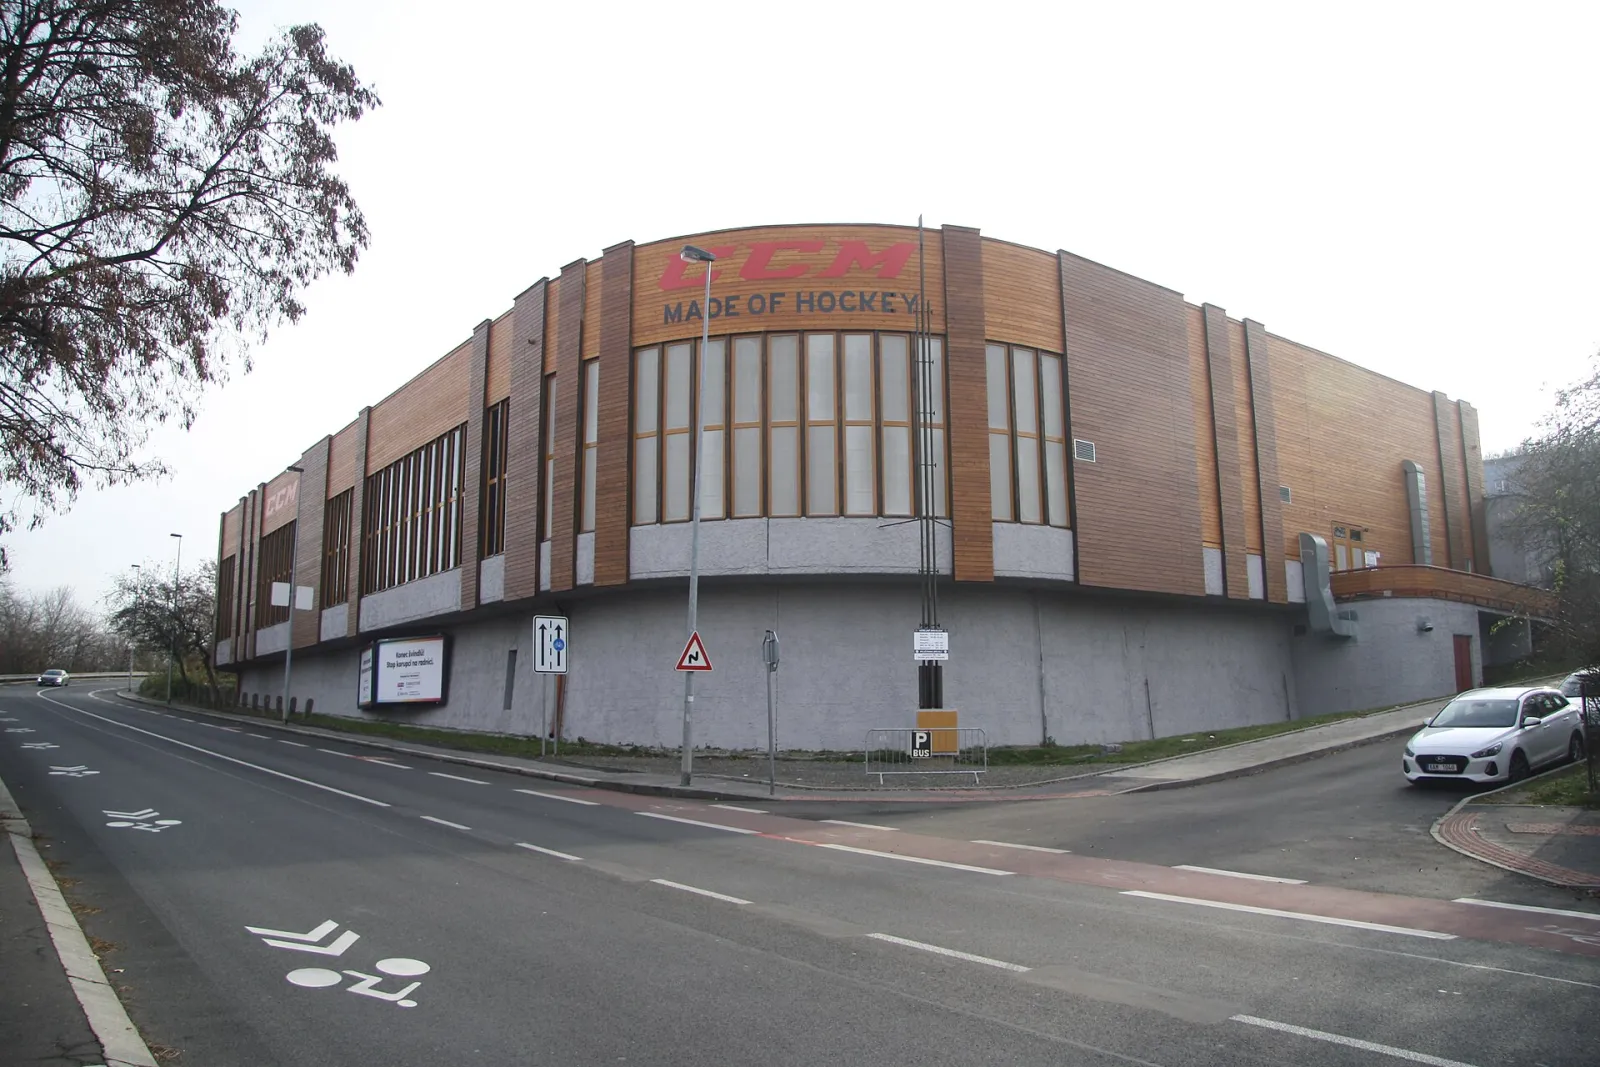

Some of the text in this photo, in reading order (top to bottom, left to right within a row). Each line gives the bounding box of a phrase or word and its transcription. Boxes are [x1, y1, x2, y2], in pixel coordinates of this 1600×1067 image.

[657, 241, 918, 291] CCM
[663, 290, 919, 325] MADE OF HOCKEY
[266, 480, 298, 516] CCM
[387, 661, 395, 669] Stop
[916, 732, 927, 748] P
[913, 749, 930, 757] BUS
